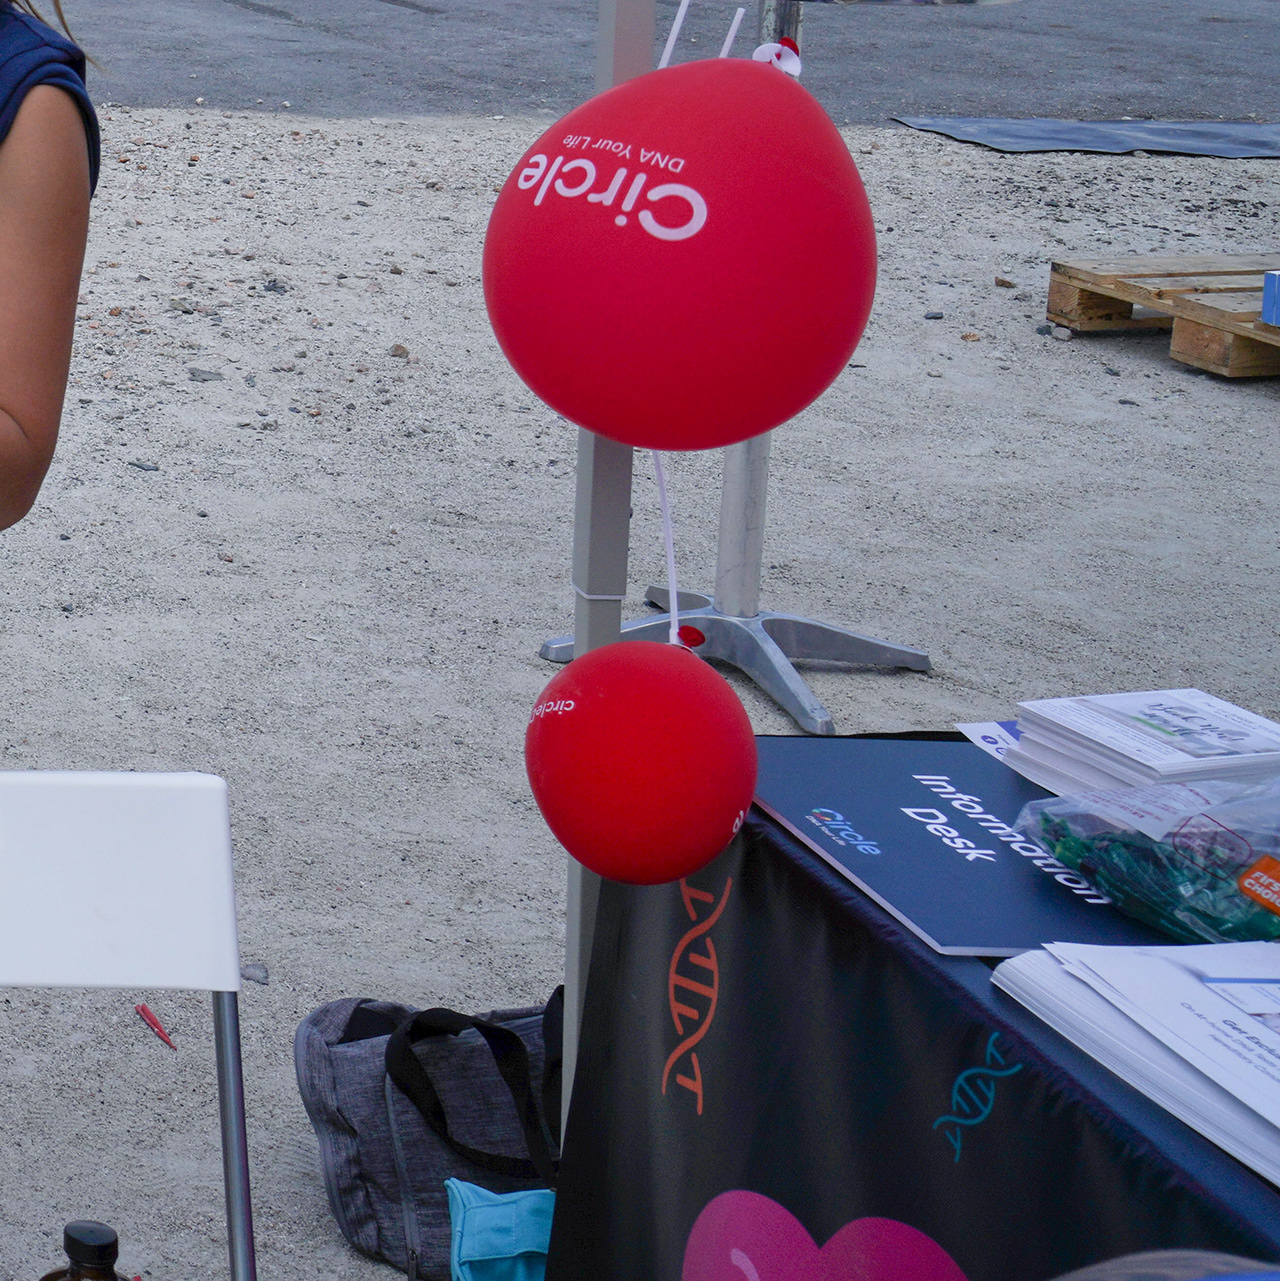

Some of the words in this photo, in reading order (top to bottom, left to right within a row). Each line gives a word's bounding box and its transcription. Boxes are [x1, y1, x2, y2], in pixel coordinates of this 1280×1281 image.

[563, 134, 591, 150] Life
[592, 138, 631, 159] Your
[640, 148, 685, 173] DNA
[517, 154, 708, 241] Circle
[811, 807, 882, 855] Circle
[899, 807, 997, 862] Desk
[911, 774, 1113, 904] Information
[1222, 1019, 1248, 1035] Get
